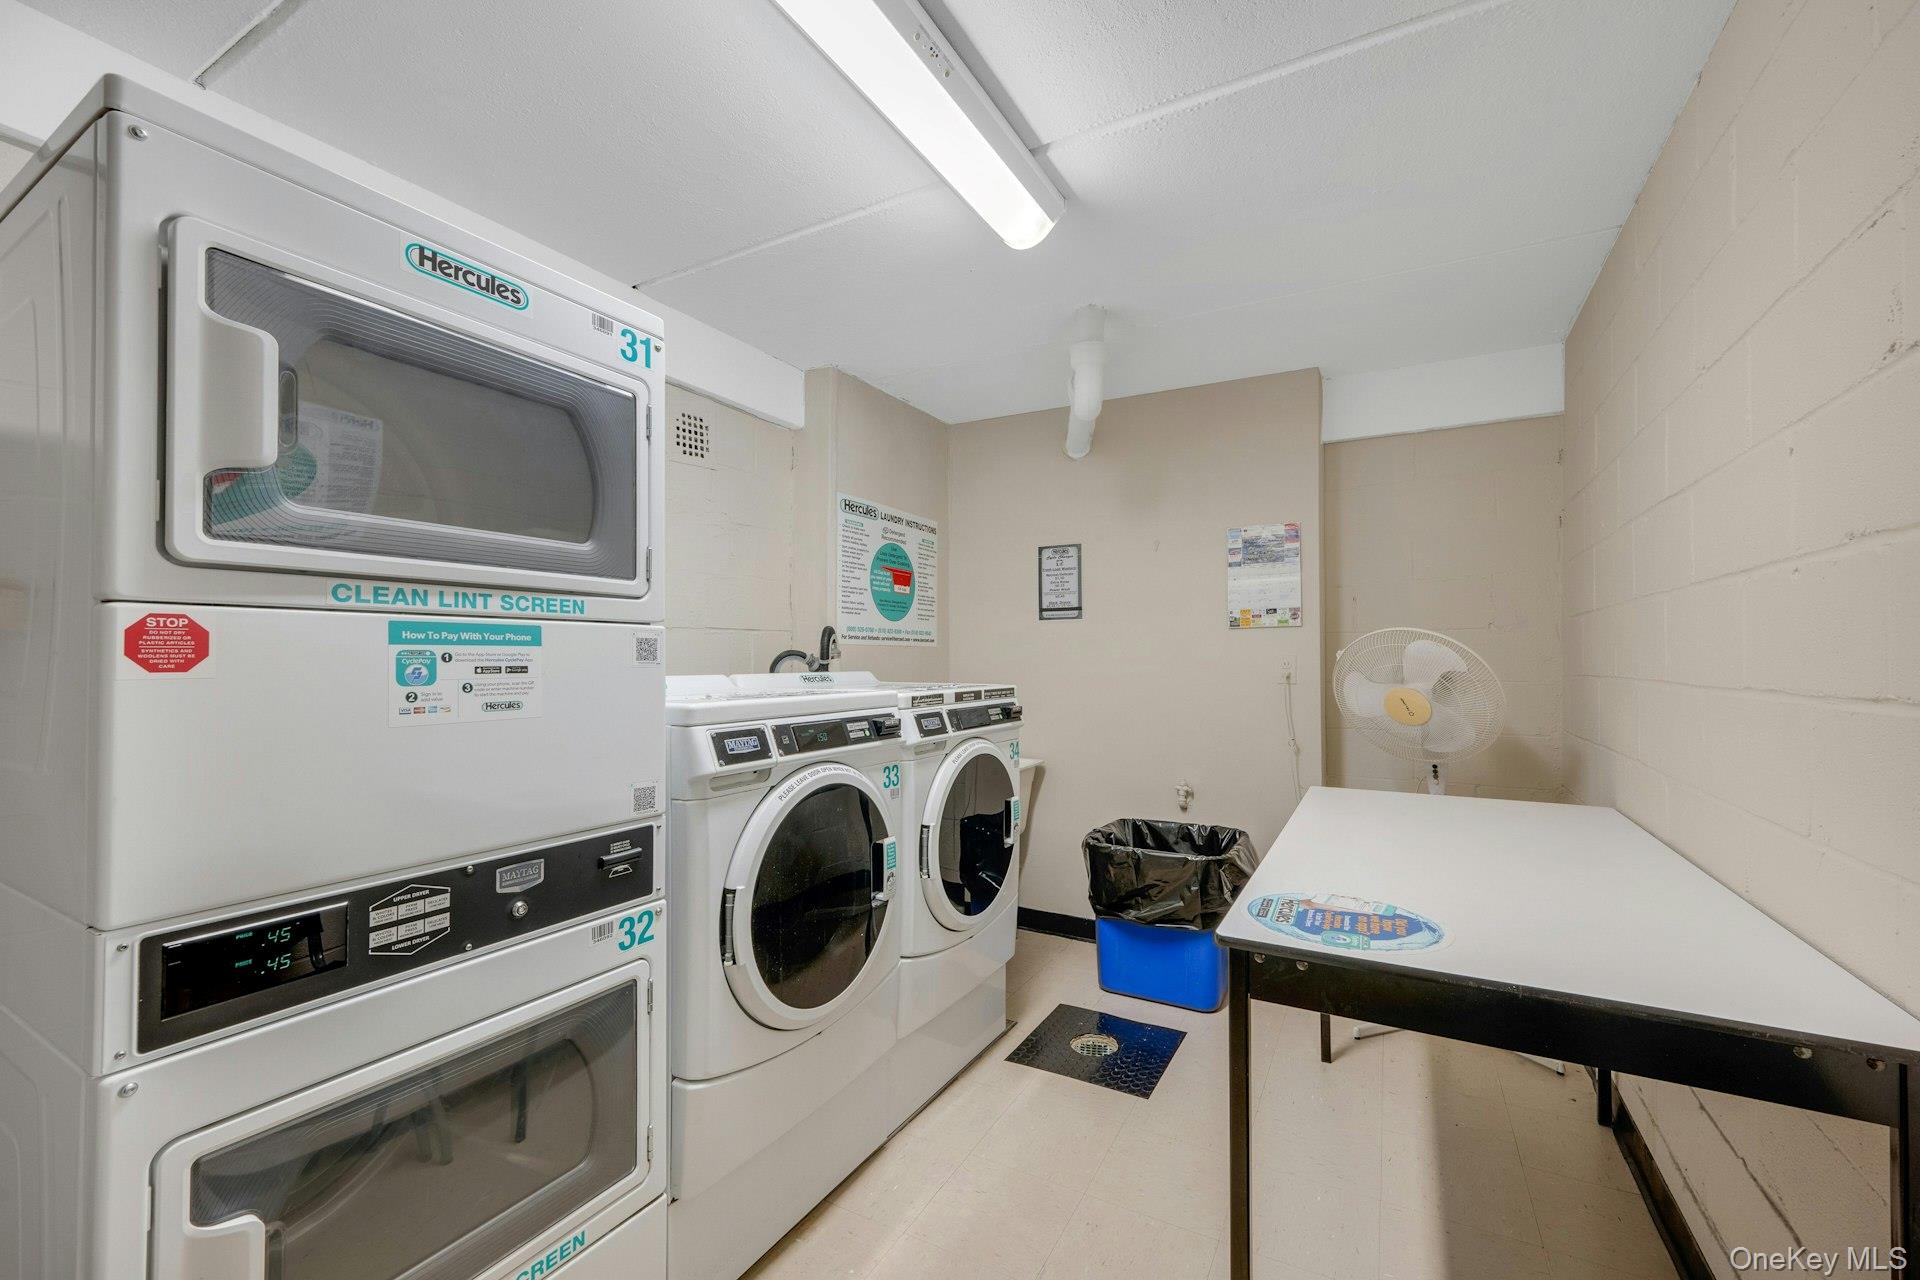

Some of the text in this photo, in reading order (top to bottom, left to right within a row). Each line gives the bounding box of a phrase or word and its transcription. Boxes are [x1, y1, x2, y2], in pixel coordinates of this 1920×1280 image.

[418, 245, 522, 305] Hercules
[620, 328, 652, 369] 31
[844, 498, 877, 518] Hercules
[880, 512, 904, 526] LAUNDRY
[905, 519, 937, 535] INSTRUCTIONS
[331, 583, 585, 615] CLEAN LINT SCREEN
[146, 617, 189, 627] STOP
[402, 630, 532, 641] How To Pay With Your Phone
[802, 675, 832, 683] Hercules
[486, 702, 520, 710] Hercules
[728, 738, 759, 749] MAYTAG
[1010, 741, 1019, 760] 34
[883, 764, 900, 789] 33
[778, 784, 796, 801] PLEASE
[794, 774, 809, 786] LEAVE
[502, 865, 539, 881] MAYTAG
[393, 889, 430, 902] UPPER DRYER
[1276, 898, 1300, 924] Hercules
[618, 910, 655, 952] 32
[392, 935, 430, 951] LOWER DRYER
